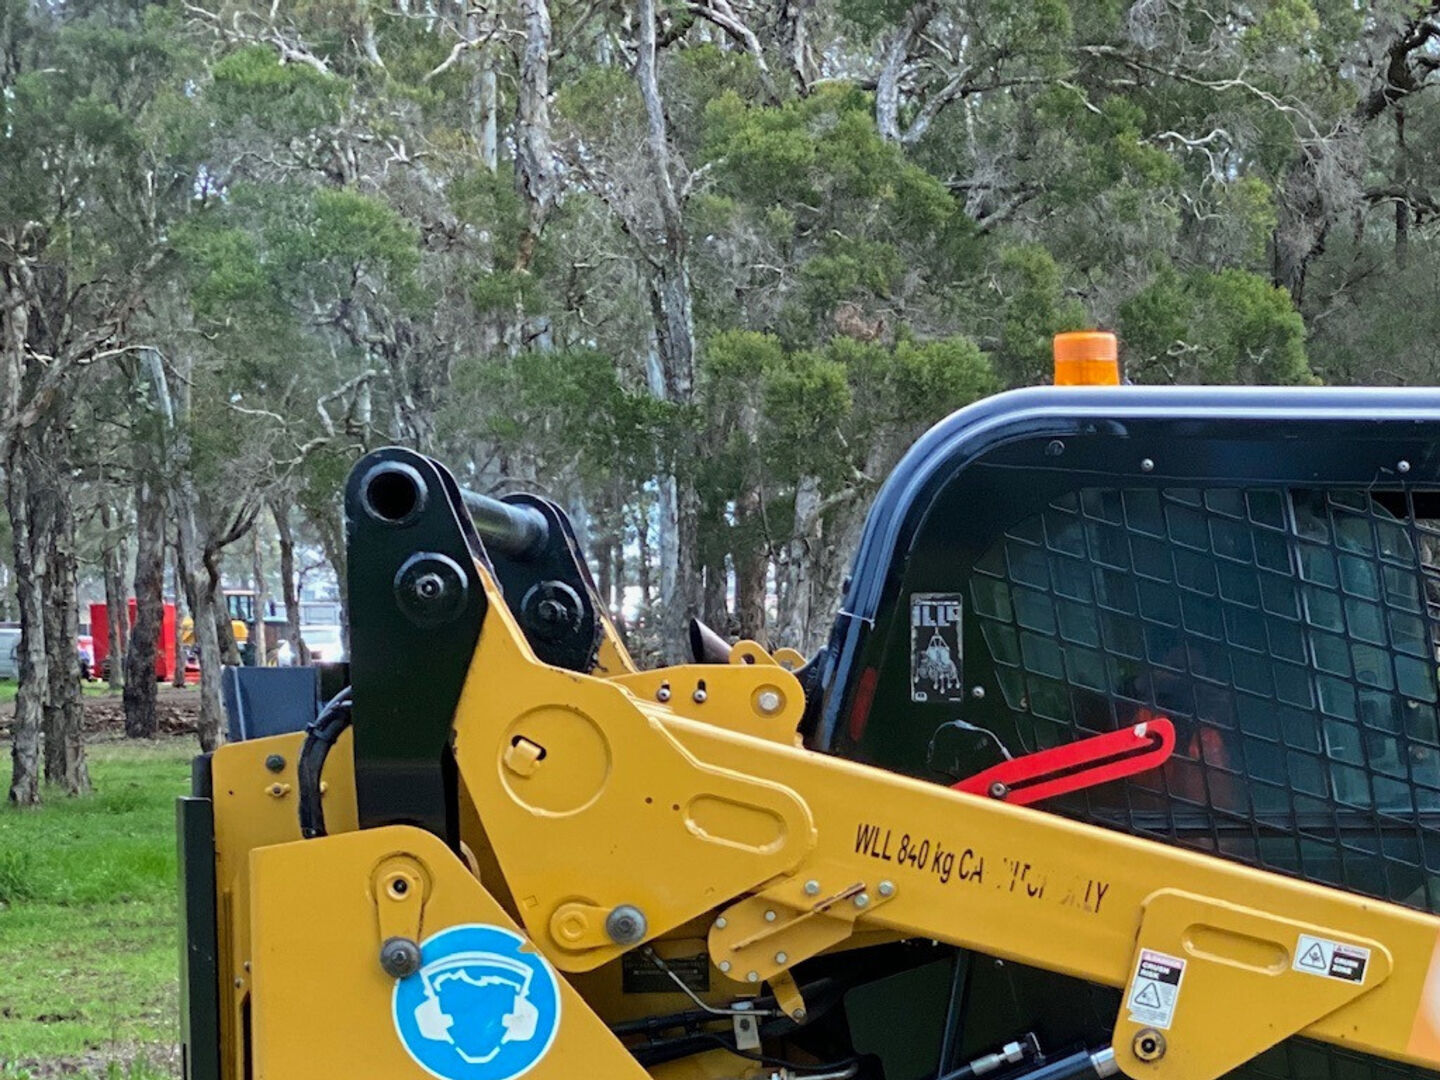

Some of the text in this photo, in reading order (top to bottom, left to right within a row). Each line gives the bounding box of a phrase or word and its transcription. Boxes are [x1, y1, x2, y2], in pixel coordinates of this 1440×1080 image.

[854, 823, 892, 861] WLL
[897, 833, 930, 870] 840
[931, 842, 955, 884] kg
